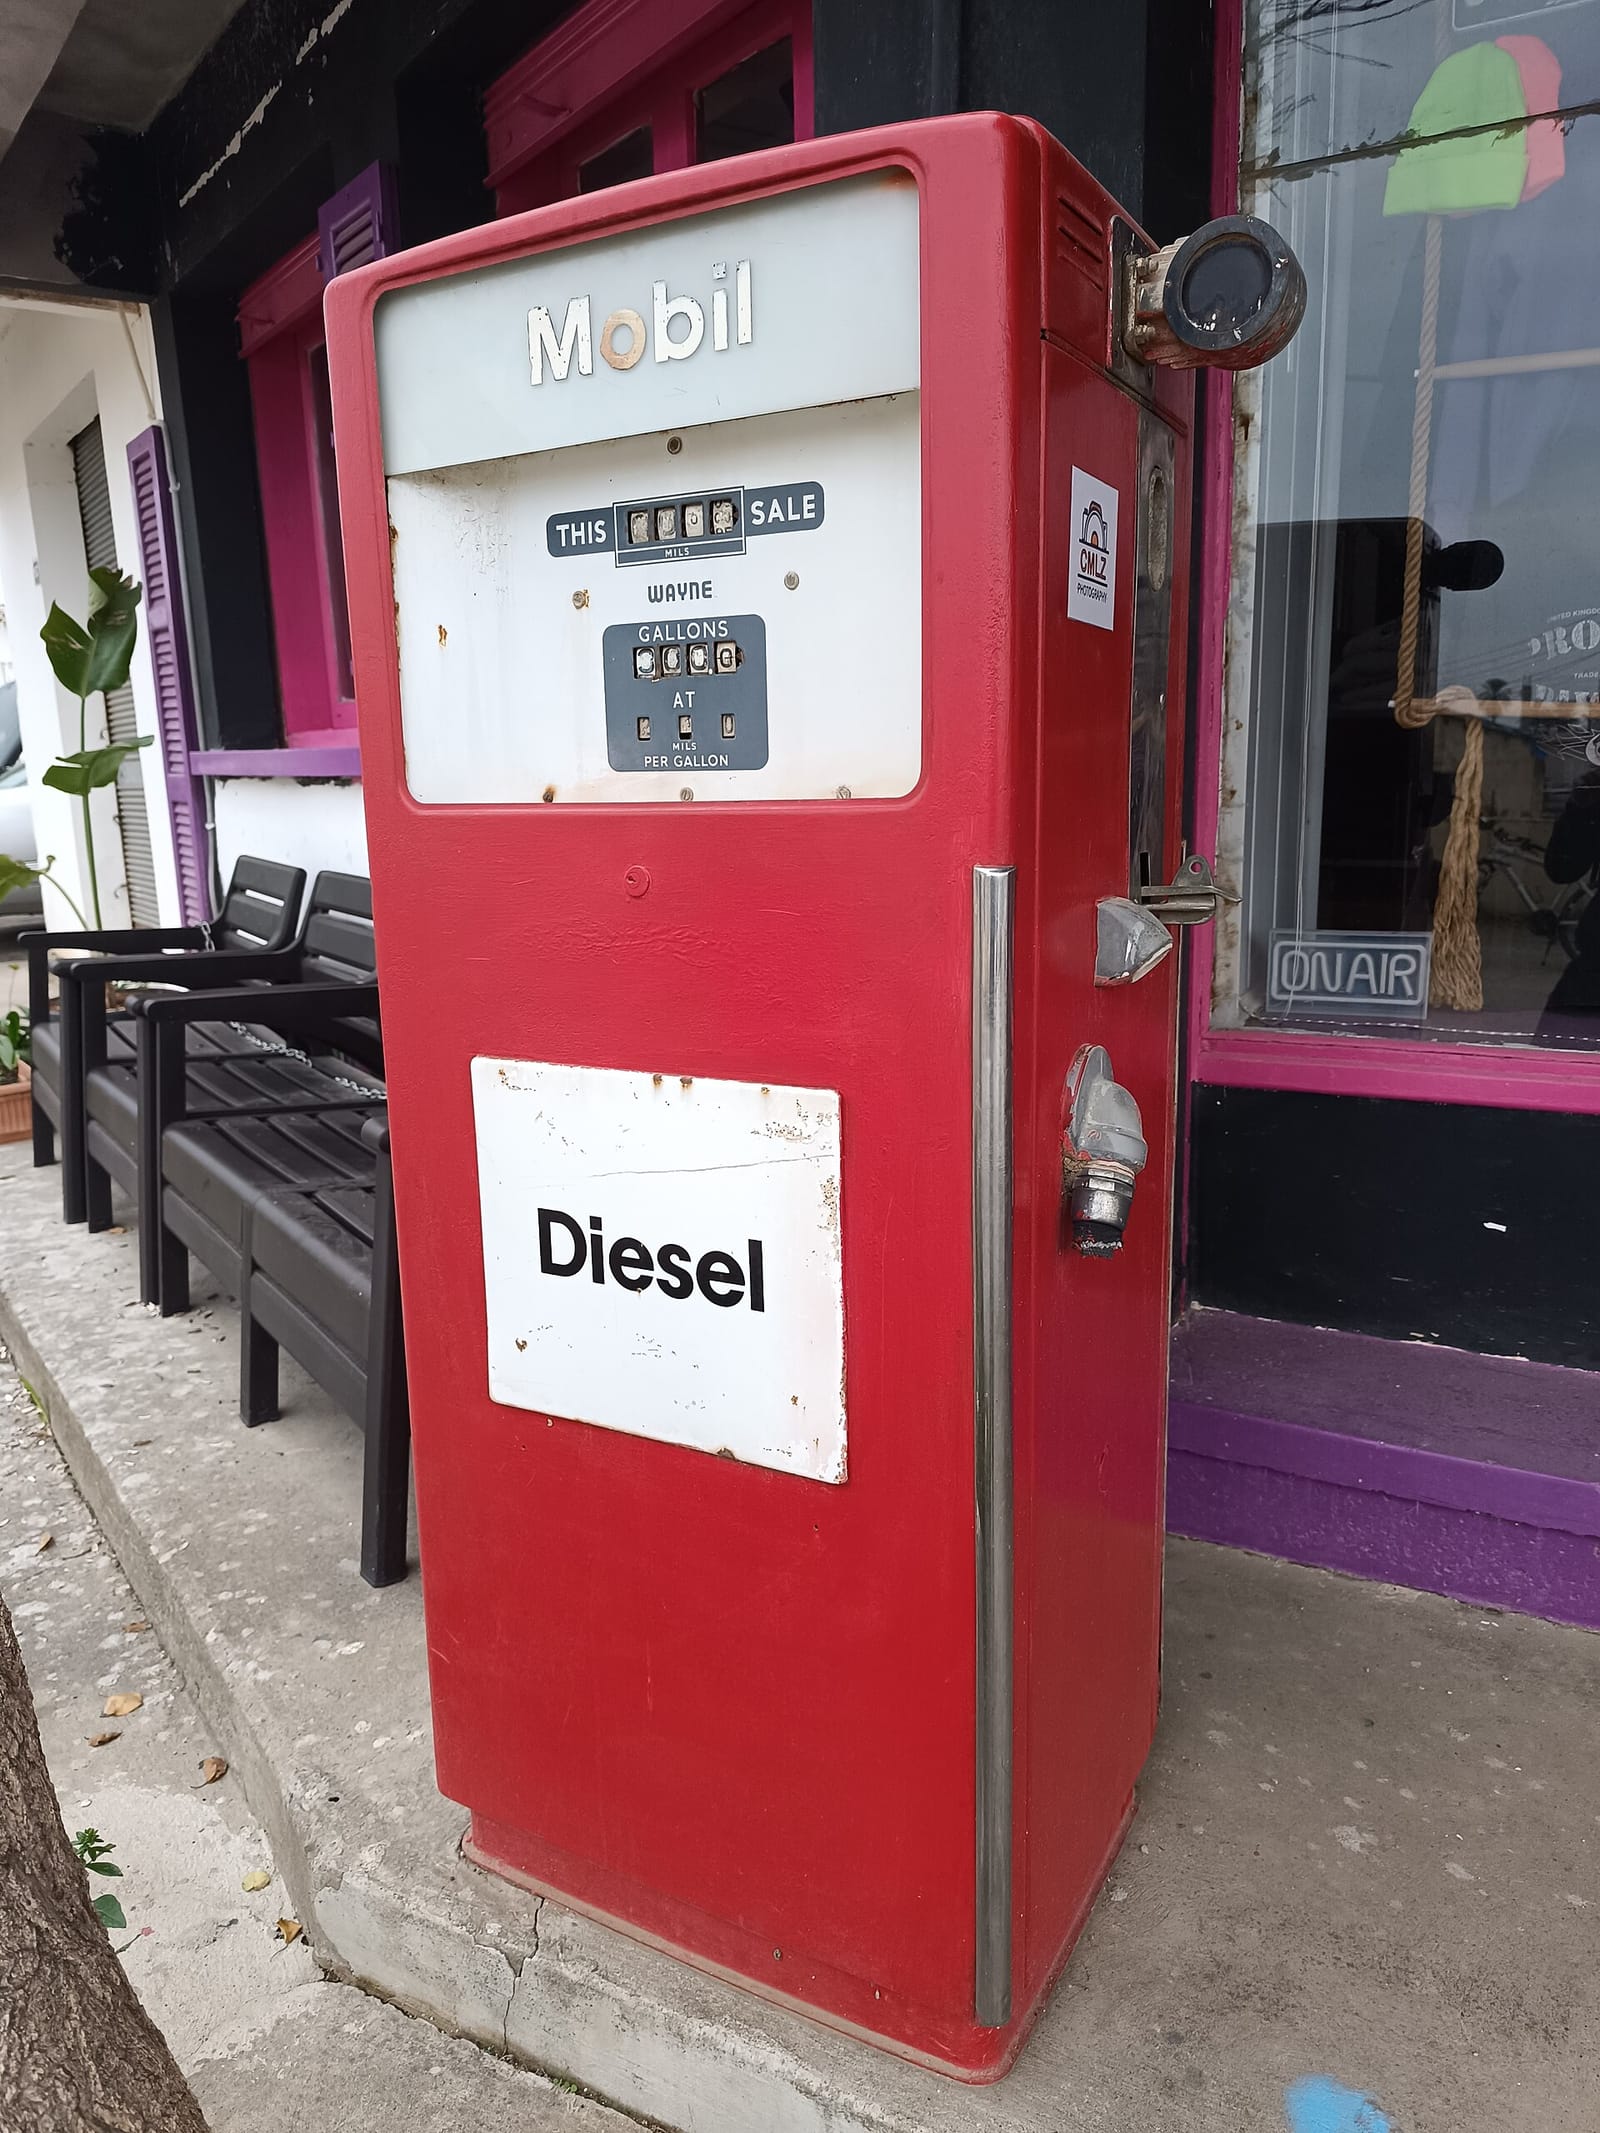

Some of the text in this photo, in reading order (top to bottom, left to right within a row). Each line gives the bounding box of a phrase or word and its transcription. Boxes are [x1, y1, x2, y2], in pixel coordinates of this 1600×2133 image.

[527, 257, 753, 385] Mobil
[556, 520, 607, 547] THIS
[751, 494, 816, 526] SALE
[664, 546, 690, 558] MILS
[648, 580, 713, 603] WAYNE
[1077, 583, 1107, 603] PHOTOGRAPHY
[638, 621, 729, 642] GALLONS
[673, 691, 696, 709] AT
[672, 742, 697, 751] MILS
[644, 754, 729, 768] PER GALLON
[1281, 950, 1417, 996] ON AIR
[537, 1207, 765, 1313] Diesel
